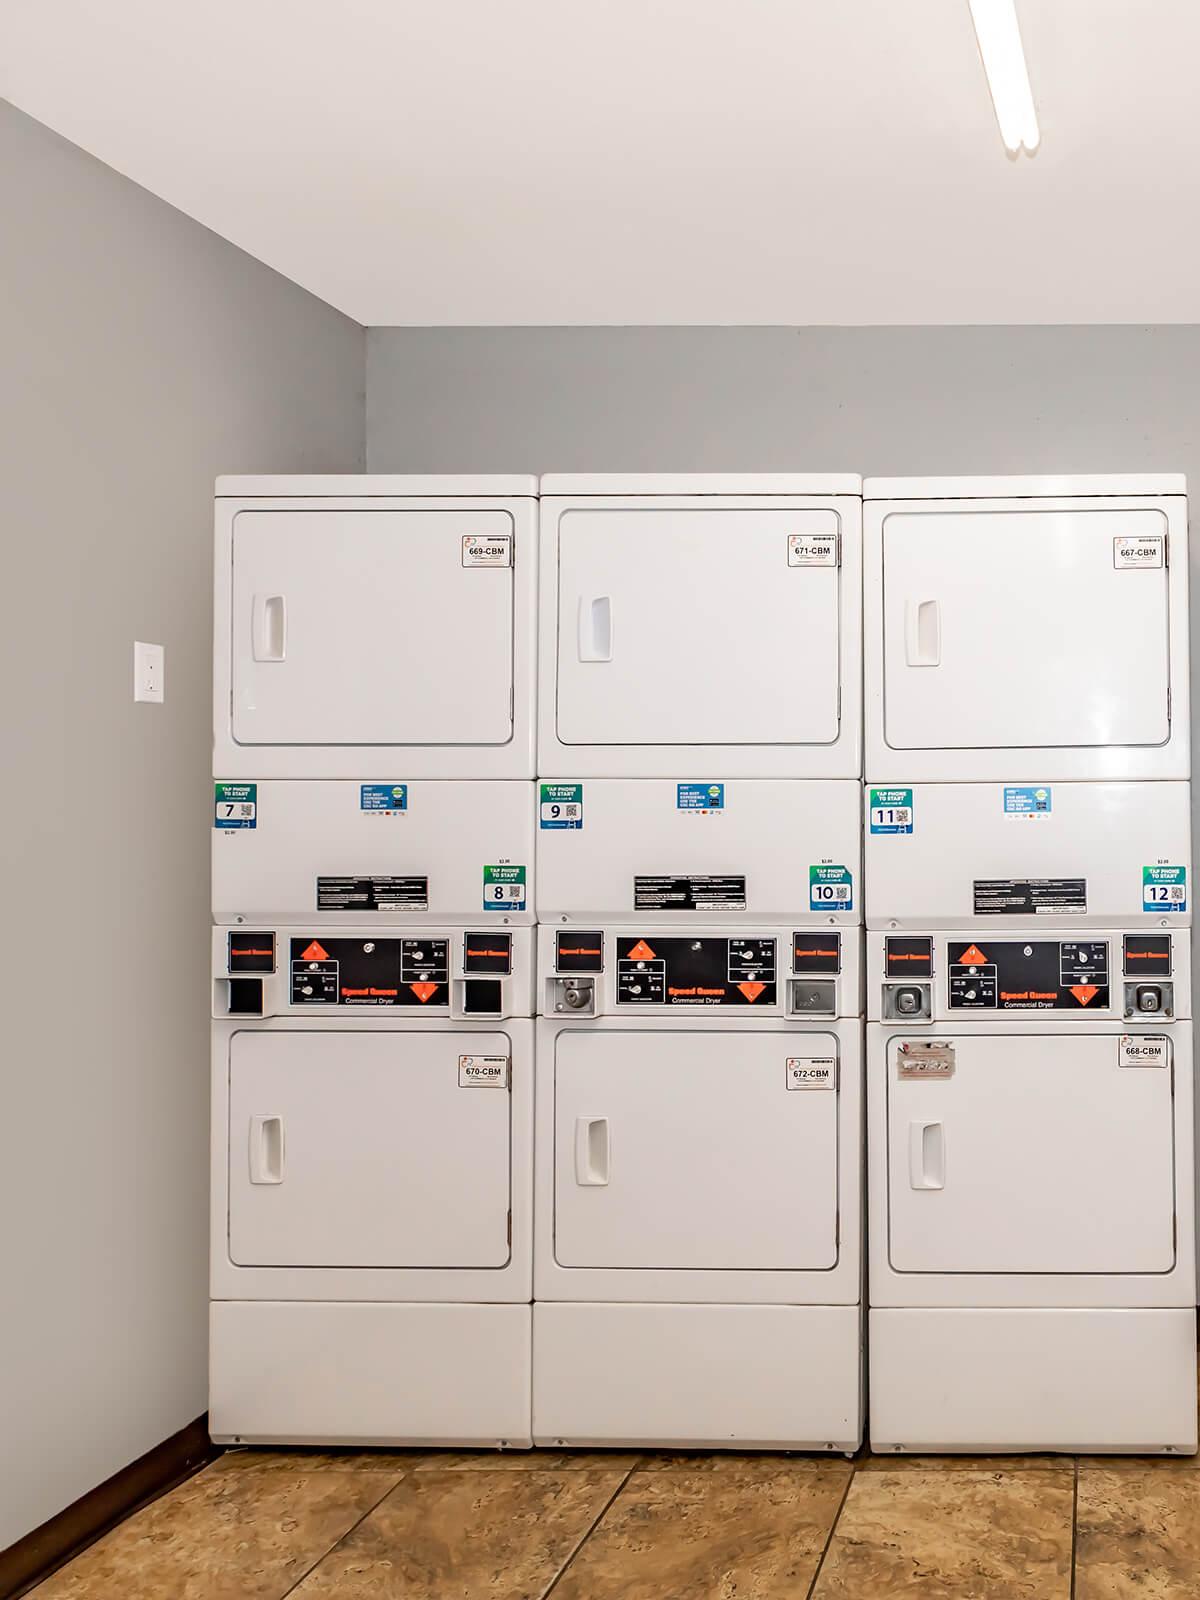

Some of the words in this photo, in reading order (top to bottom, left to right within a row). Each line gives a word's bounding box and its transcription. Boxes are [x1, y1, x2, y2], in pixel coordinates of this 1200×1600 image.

[469, 547, 505, 555] 669-CBM
[795, 547, 830, 555] 671-CBM
[225, 804, 234, 817] 7
[551, 805, 560, 818] 9
[877, 810, 893, 823] 11
[494, 886, 503, 900] 8
[816, 886, 833, 899] 10
[1150, 887, 1168, 900] 12
[341, 987, 368, 996] Speed
[370, 987, 397, 996] Queen
[668, 987, 696, 996] Speed
[697, 987, 725, 995] Queen
[1000, 992, 1028, 1000] Speed
[378, 997, 394, 1005] Dryer
[706, 997, 721, 1005] Dryer
[1038, 1001, 1054, 1009] Dryer
[1126, 1047, 1161, 1055] 668-CBM
[793, 1070, 829, 1078] 672-CBM
